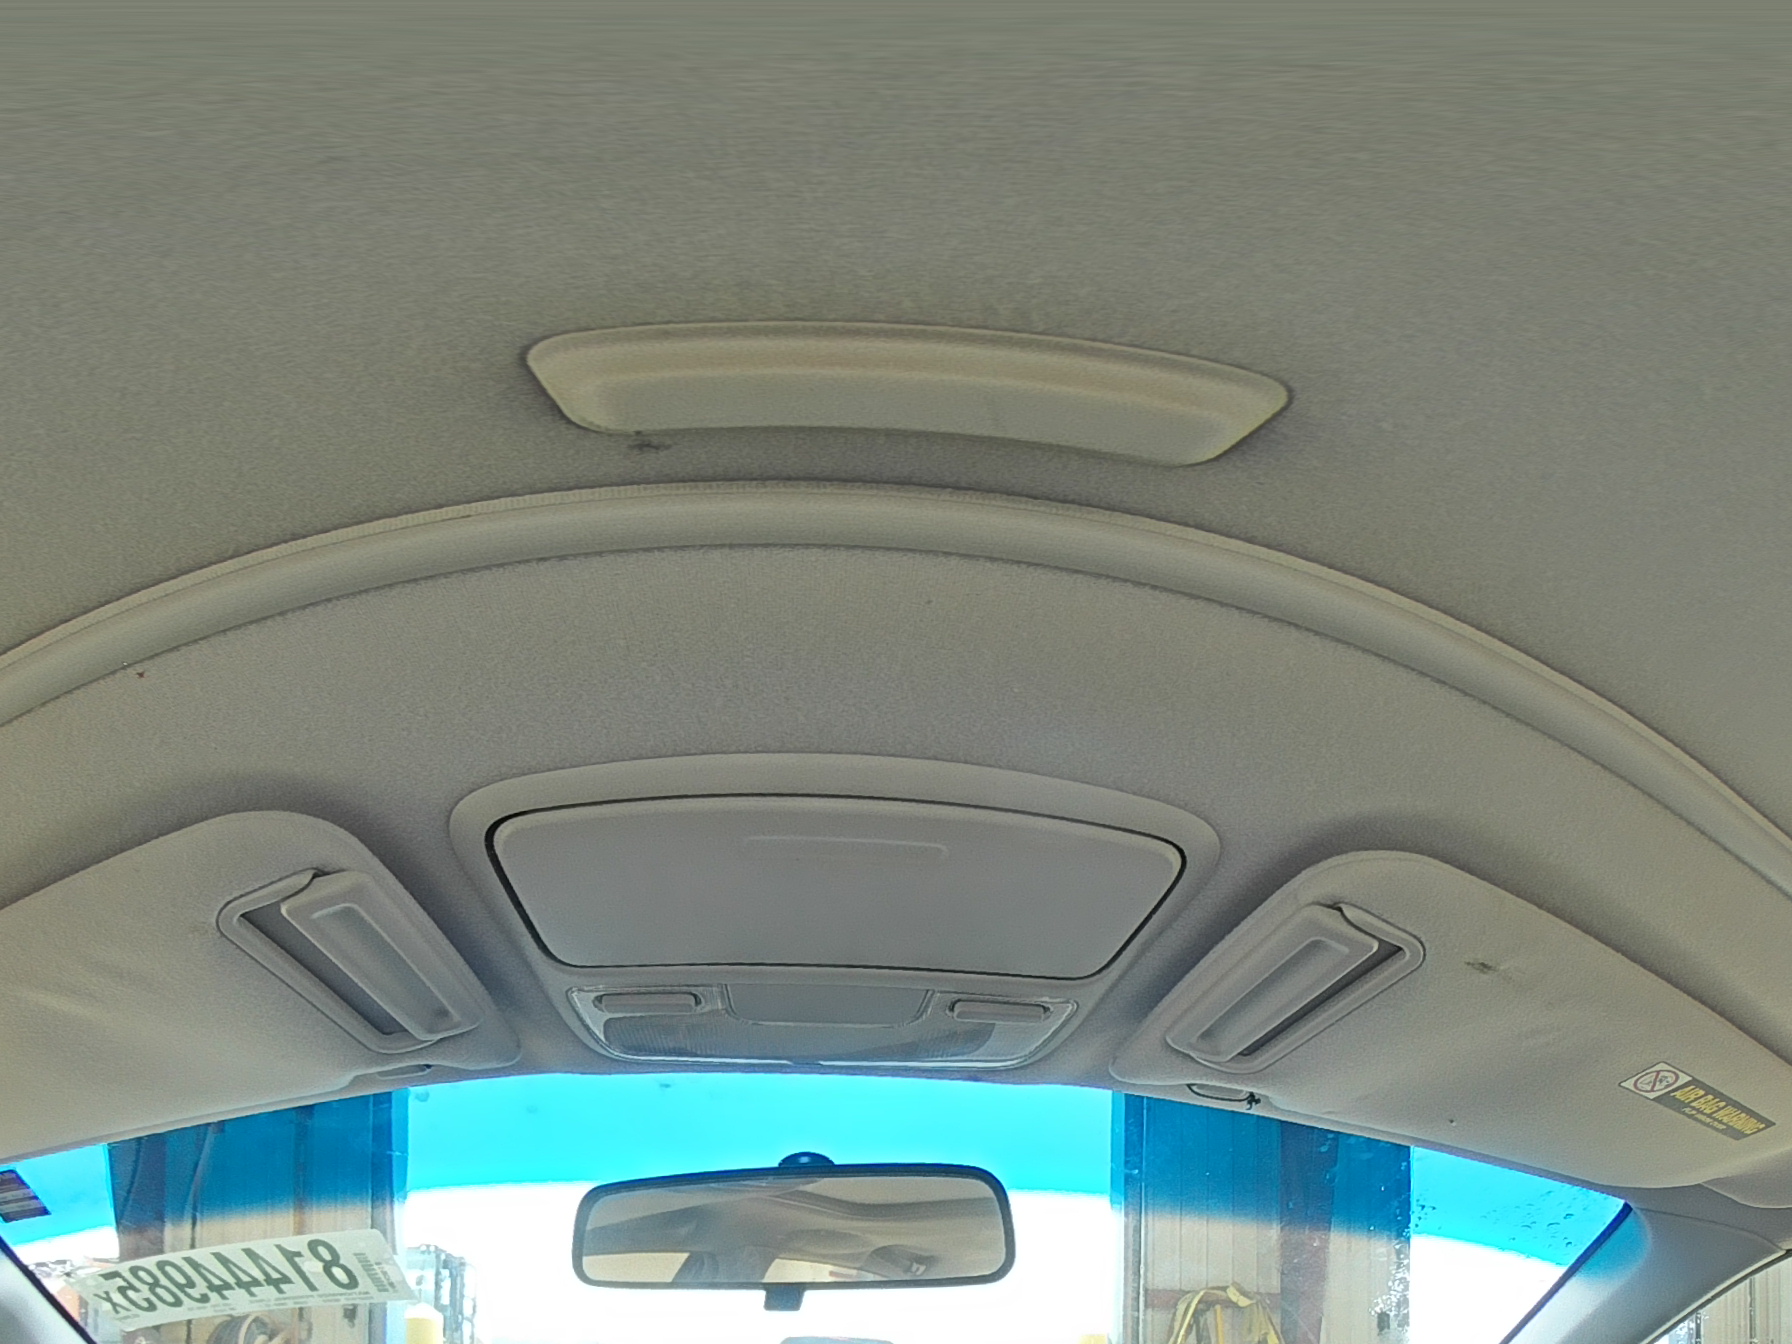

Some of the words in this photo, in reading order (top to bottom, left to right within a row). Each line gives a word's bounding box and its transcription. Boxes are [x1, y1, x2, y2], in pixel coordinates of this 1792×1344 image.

[1670, 1086, 1705, 1103] AIR
[1690, 1095, 1726, 1113] BAG
[1712, 1106, 1765, 1134] WARNING
